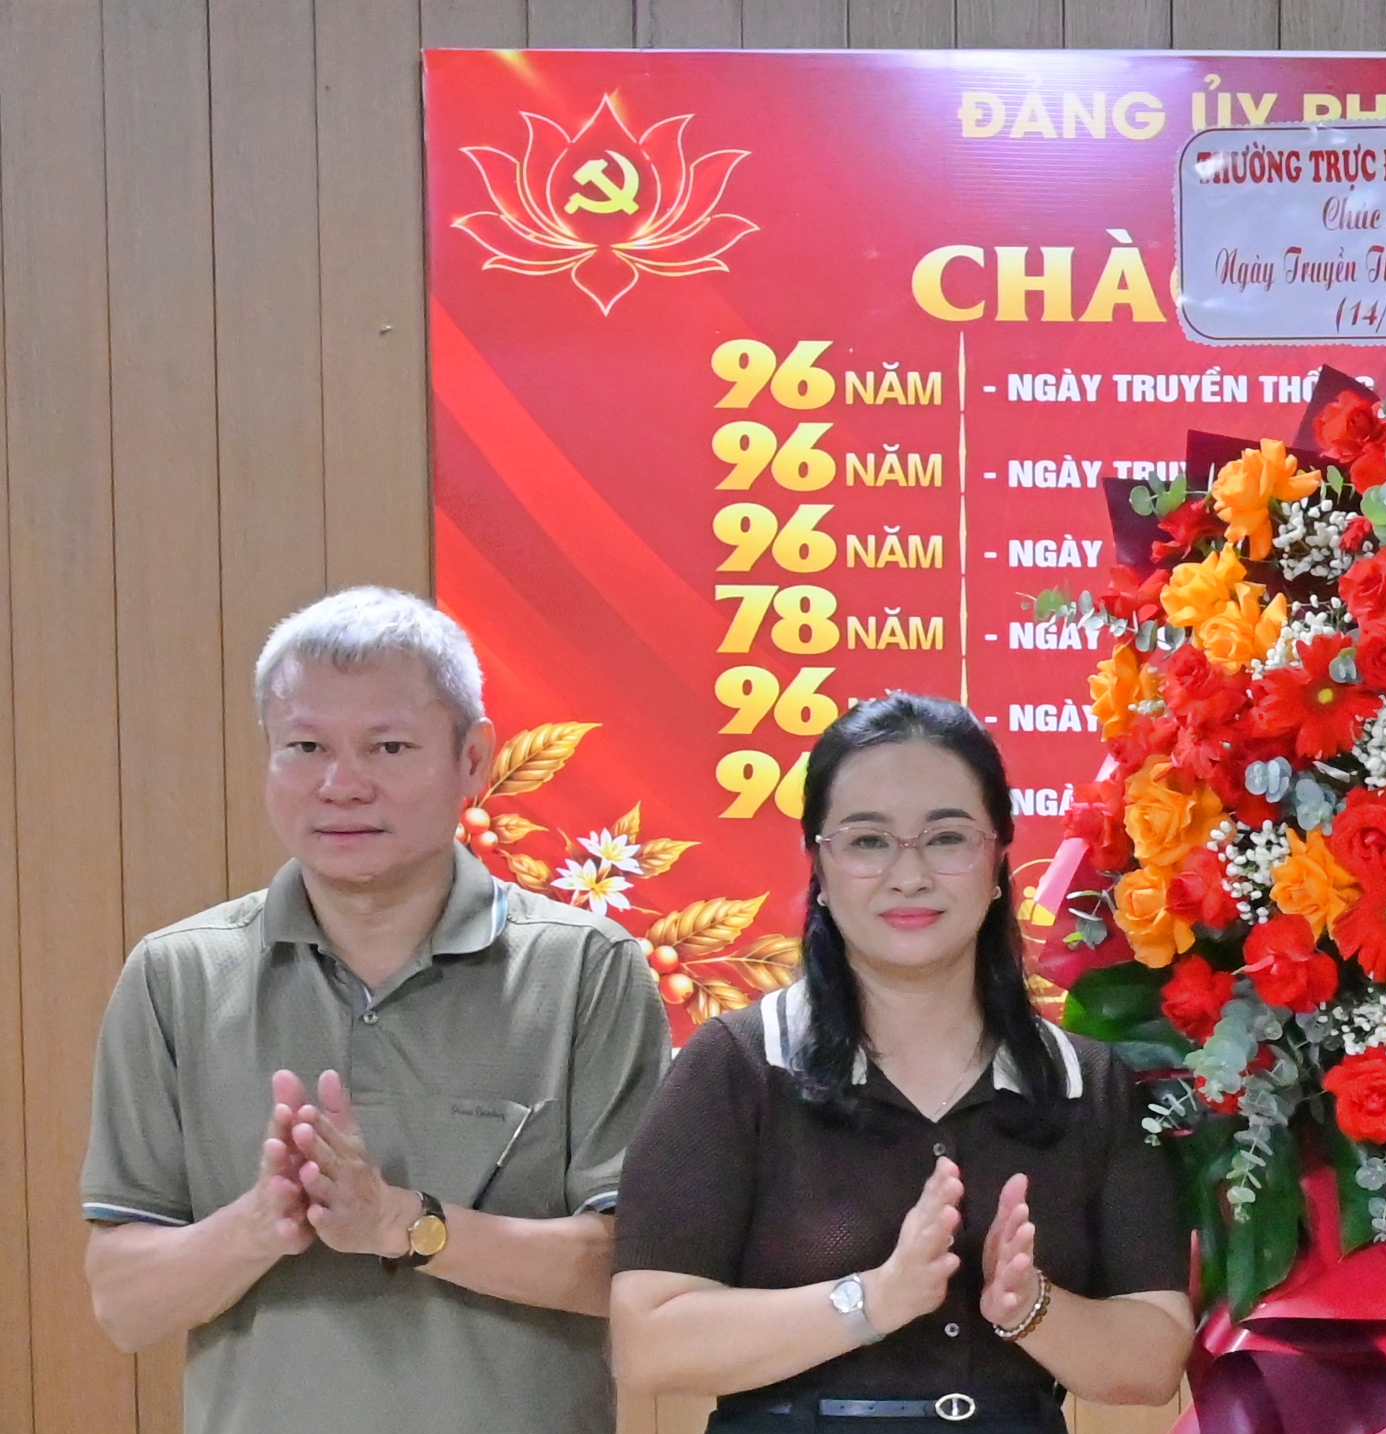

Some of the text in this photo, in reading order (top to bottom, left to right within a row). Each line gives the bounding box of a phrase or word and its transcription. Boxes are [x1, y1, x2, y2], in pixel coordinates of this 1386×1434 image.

[1196, 141, 1302, 184] THƯỜNG
[1309, 143, 1376, 191] TRỰC
[1322, 195, 1381, 231] Chúc
[911, 229, 1180, 322] CHÀ
[1215, 247, 1275, 292] Ngày
[1283, 246, 1358, 291] Truyền
[711, 338, 835, 410] 96
[845, 362, 941, 405] NĂM
[1009, 367, 1101, 402] NGÀY
[1113, 366, 1248, 402] TRUYỀN
[1259, 365, 1375, 403] THỐ
[711, 420, 835, 491] 96
[845, 444, 942, 487] NĂM
[1008, 455, 1102, 488] NGÀY
[712, 503, 836, 573] 96
[846, 526, 943, 569] NĂM
[1009, 534, 1102, 568] NGÀY
[714, 584, 840, 654] 78
[847, 607, 944, 650] NĂM
[714, 666, 838, 735] 96
[1009, 699, 1099, 731] NGÀY
[1010, 783, 1074, 816] NGÀ
